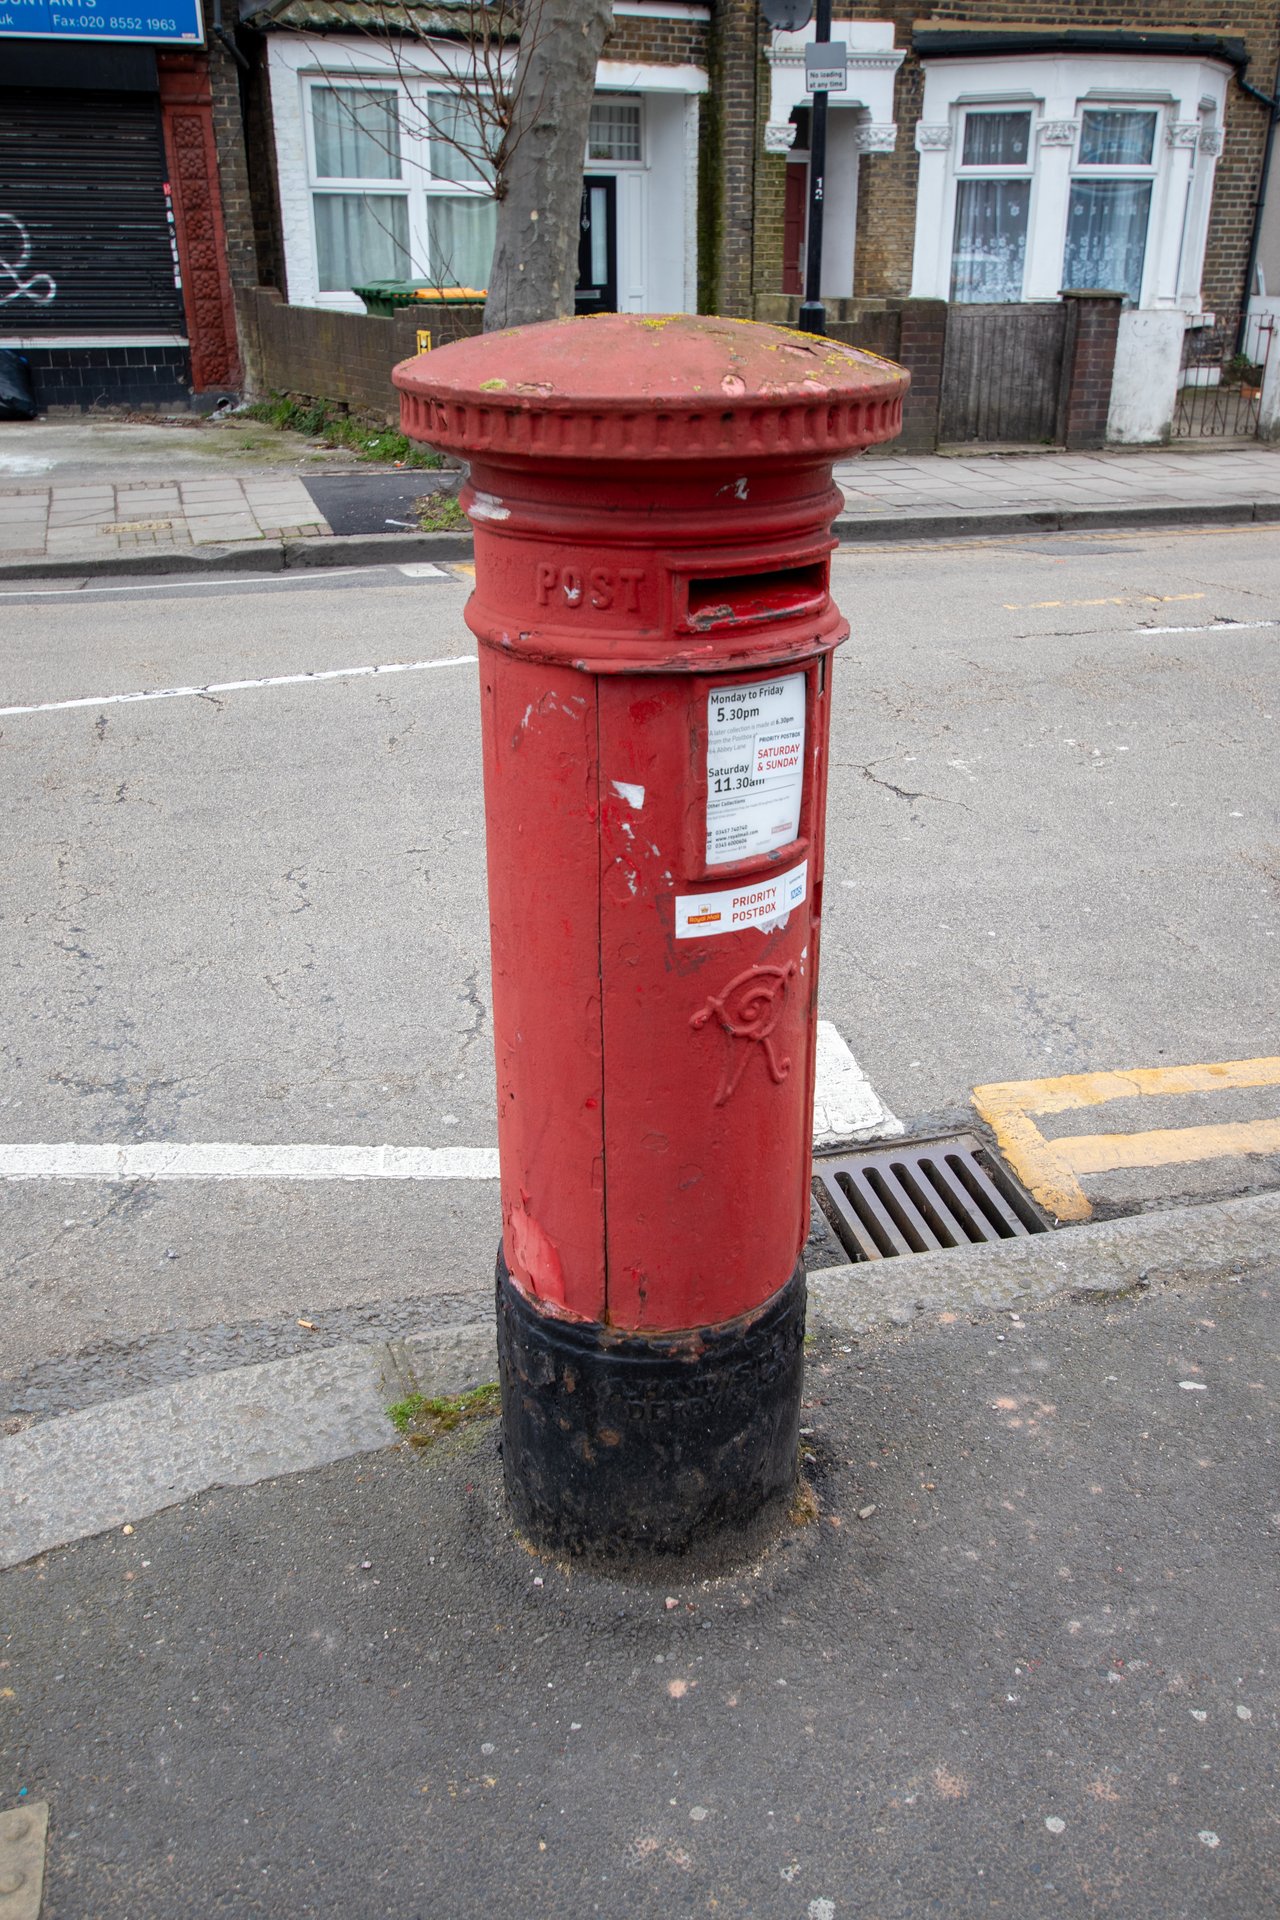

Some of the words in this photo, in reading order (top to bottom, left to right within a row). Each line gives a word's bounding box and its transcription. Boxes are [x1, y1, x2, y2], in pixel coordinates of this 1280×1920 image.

[110, 17, 142, 29] 8552
[147, 18, 176, 31] 1963
[820, 71, 842, 79] loading
[538, 562, 645, 613] POST
[711, 692, 747, 705] Monday
[749, 691, 758, 699] to
[759, 686, 784, 698] Friday
[717, 707, 760, 722] 5.30pm
[759, 734, 780, 743] PRIORITY
[780, 731, 801, 740] POSTBOX
[757, 743, 800, 759] SATURDAY
[708, 764, 749, 777] Saturday
[757, 762, 763, 772] &
[766, 757, 798, 770] SUNDAY
[714, 777, 765, 793] 11.30am
[732, 886, 777, 909] PRIORITY
[689, 915, 706, 924] Royal
[707, 913, 720, 921] Mail
[732, 901, 777, 923] POSTBOX
